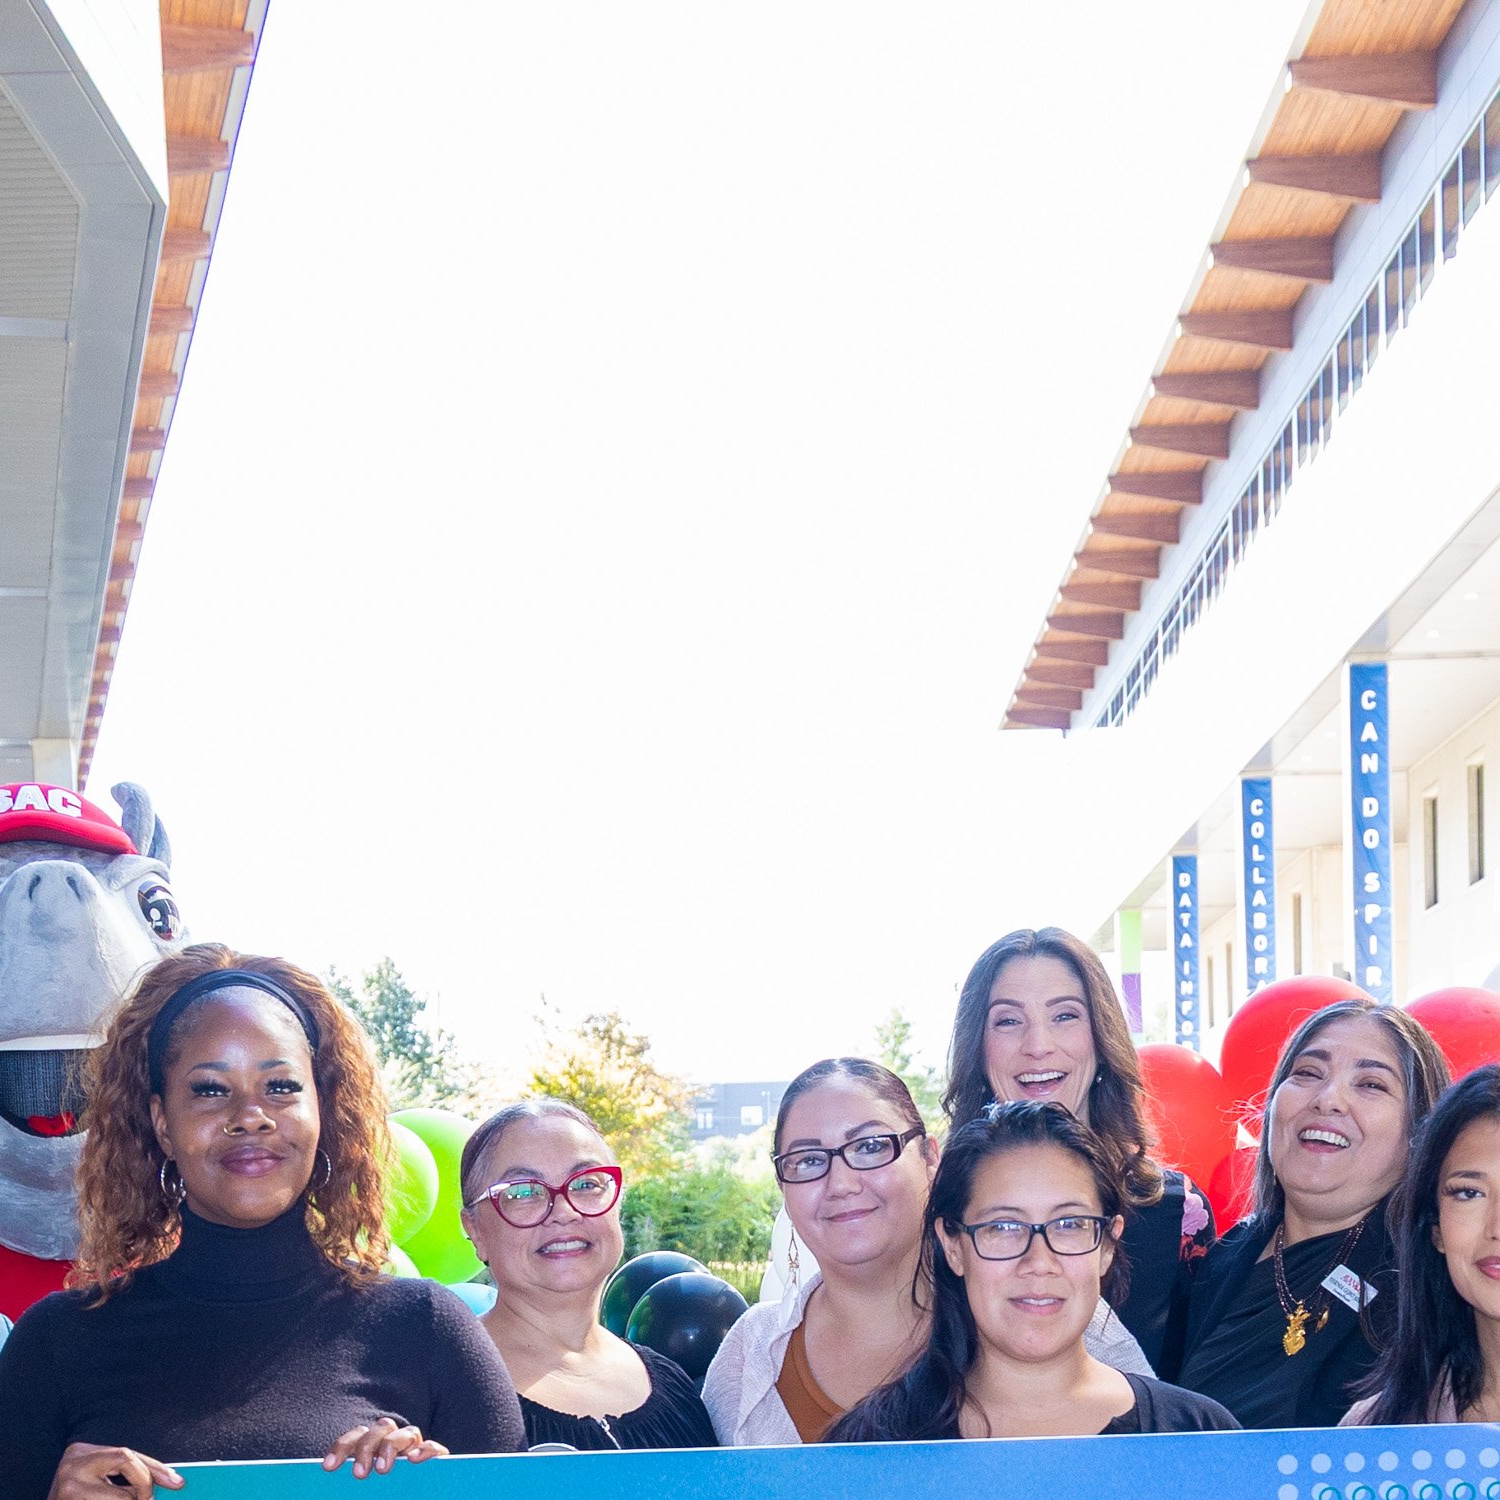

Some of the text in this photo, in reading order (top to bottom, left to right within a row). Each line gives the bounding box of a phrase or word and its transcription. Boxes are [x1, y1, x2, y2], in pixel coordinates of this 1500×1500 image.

[1178, 872, 1193, 948] DATA
[1360, 689, 1383, 988] CAN DO SPIR
